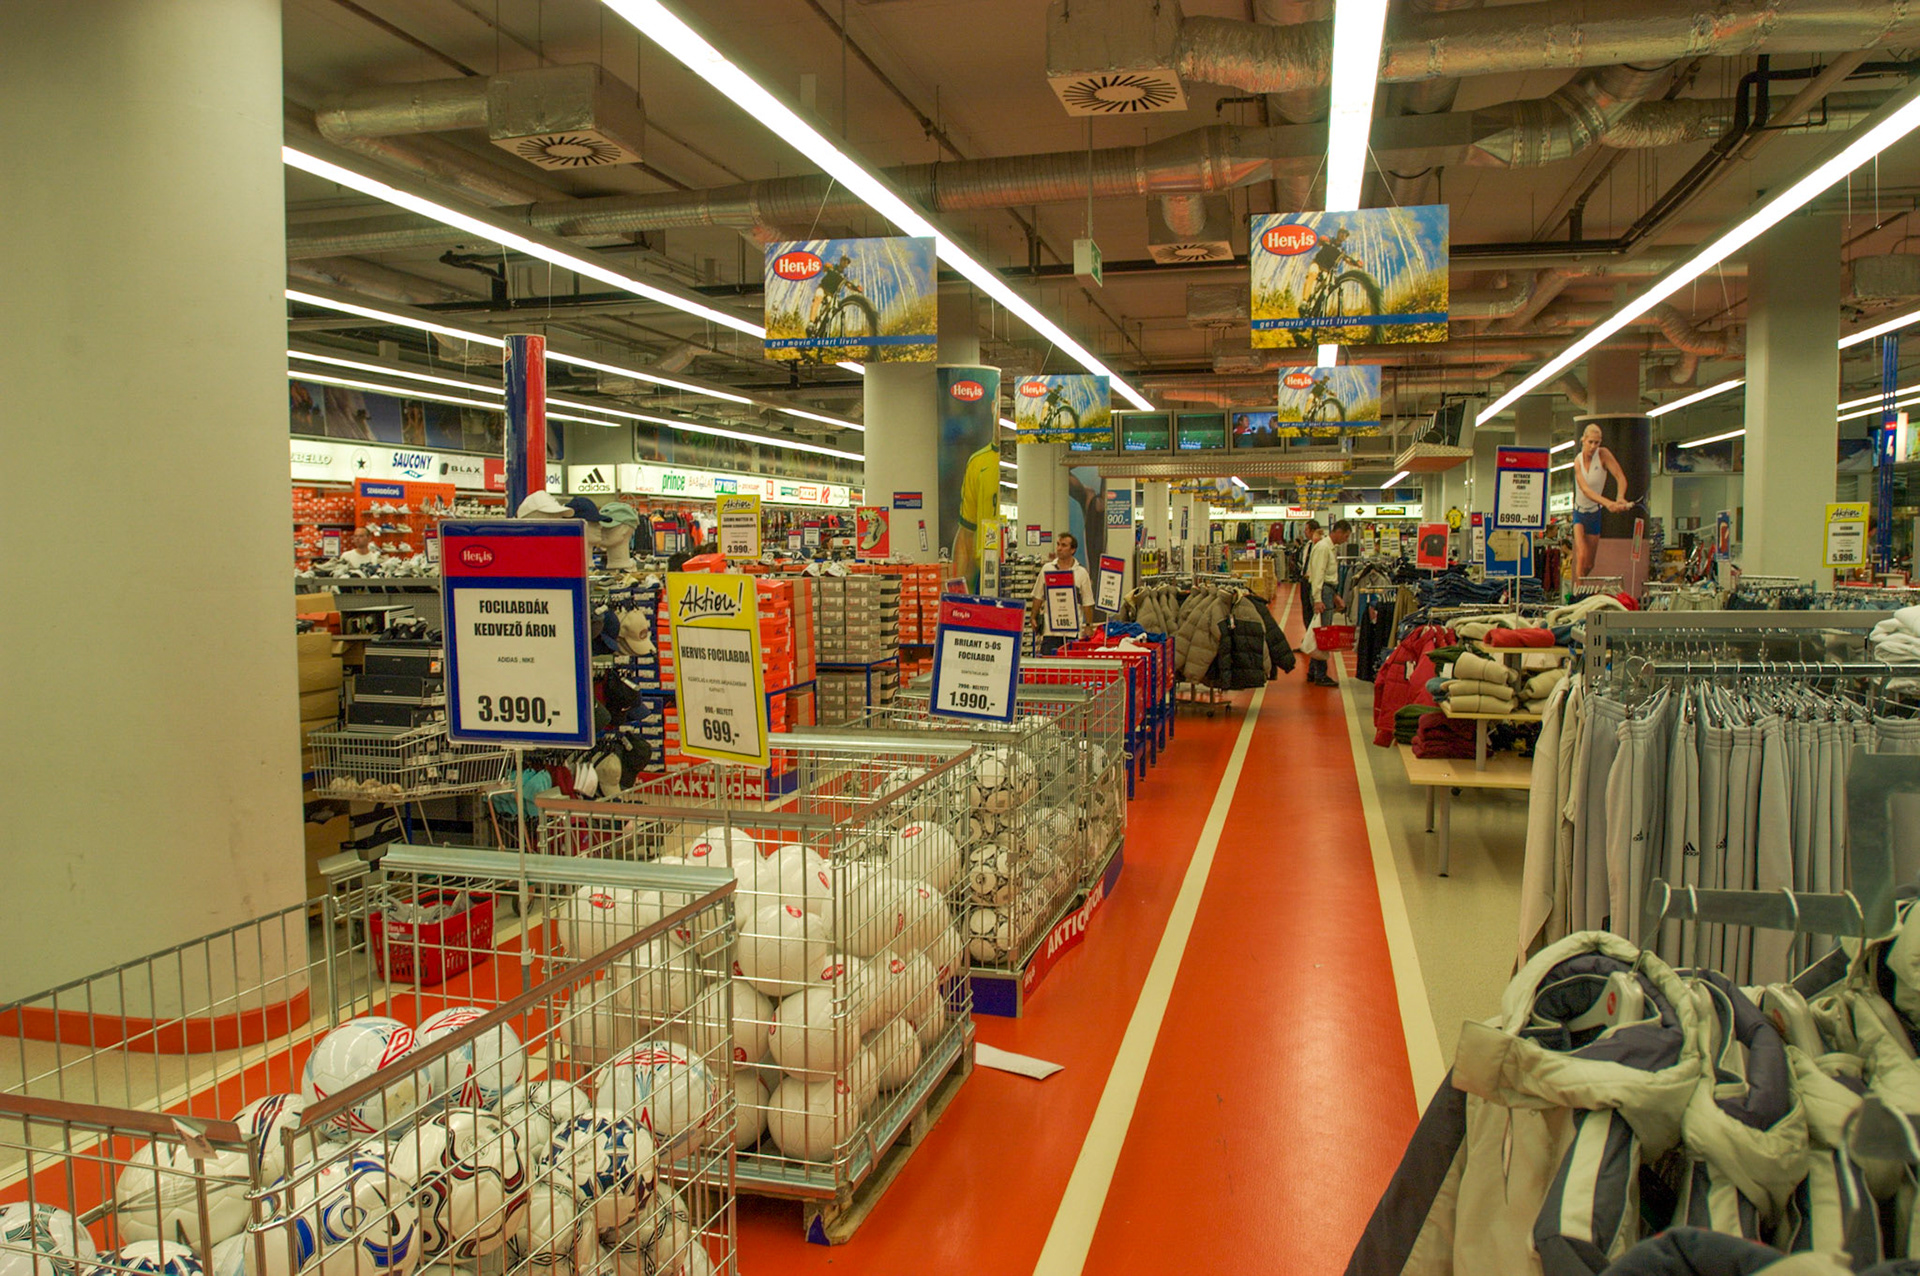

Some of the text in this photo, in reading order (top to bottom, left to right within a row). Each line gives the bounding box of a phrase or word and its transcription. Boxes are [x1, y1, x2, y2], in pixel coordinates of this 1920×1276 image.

[1267, 232, 1315, 250] Hervis
[779, 258, 821, 275] Hervis
[1260, 321, 1274, 329] get
[1311, 317, 1333, 326] start
[771, 339, 785, 348] get
[817, 338, 837, 346] start
[1287, 376, 1312, 386] Hervis
[953, 385, 983, 398] Hervis
[1022, 385, 1047, 395] Hervis
[392, 452, 433, 470] SAUCONY
[451, 465, 480, 474] BLAX
[578, 484, 611, 492] adidas
[661, 470, 686, 492] prince
[463, 549, 493, 563] Hervis
[479, 598, 549, 614] FOCILABDÁK
[679, 582, 743, 618] Aktion!
[525, 621, 556, 637] ÁRON
[954, 638, 982, 650] BRILANT
[681, 645, 750, 664] HERVIS FOCILABDA
[958, 650, 995, 662] FOCILABDA
[949, 691, 995, 712] 1.990,-
[478, 695, 560, 726] 3.990,-
[703, 718, 740, 746] 699,-
